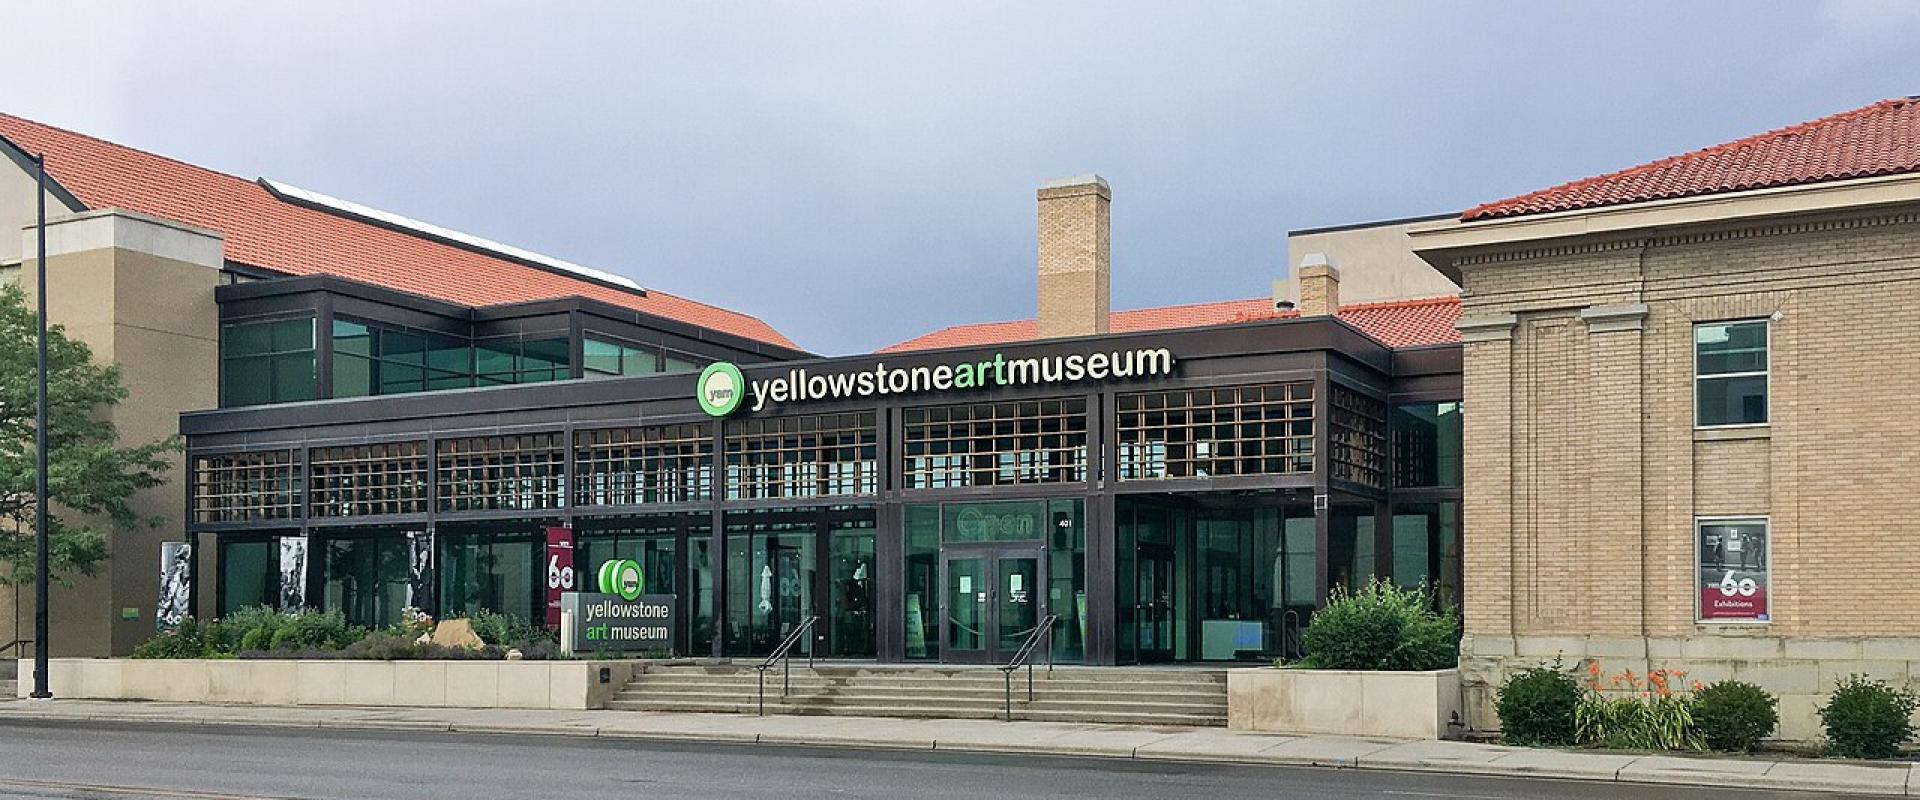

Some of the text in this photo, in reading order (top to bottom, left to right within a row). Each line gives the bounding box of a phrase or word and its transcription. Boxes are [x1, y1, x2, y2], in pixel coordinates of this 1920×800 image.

[709, 389, 733, 402] yam
[956, 507, 1034, 542] Open
[1058, 519, 1072, 528] 401
[548, 554, 574, 589] 60
[1721, 570, 1756, 597] 60
[586, 600, 669, 622] yellowstone
[1713, 599, 1753, 608] Exhibitions
[586, 623, 668, 640] art museum
